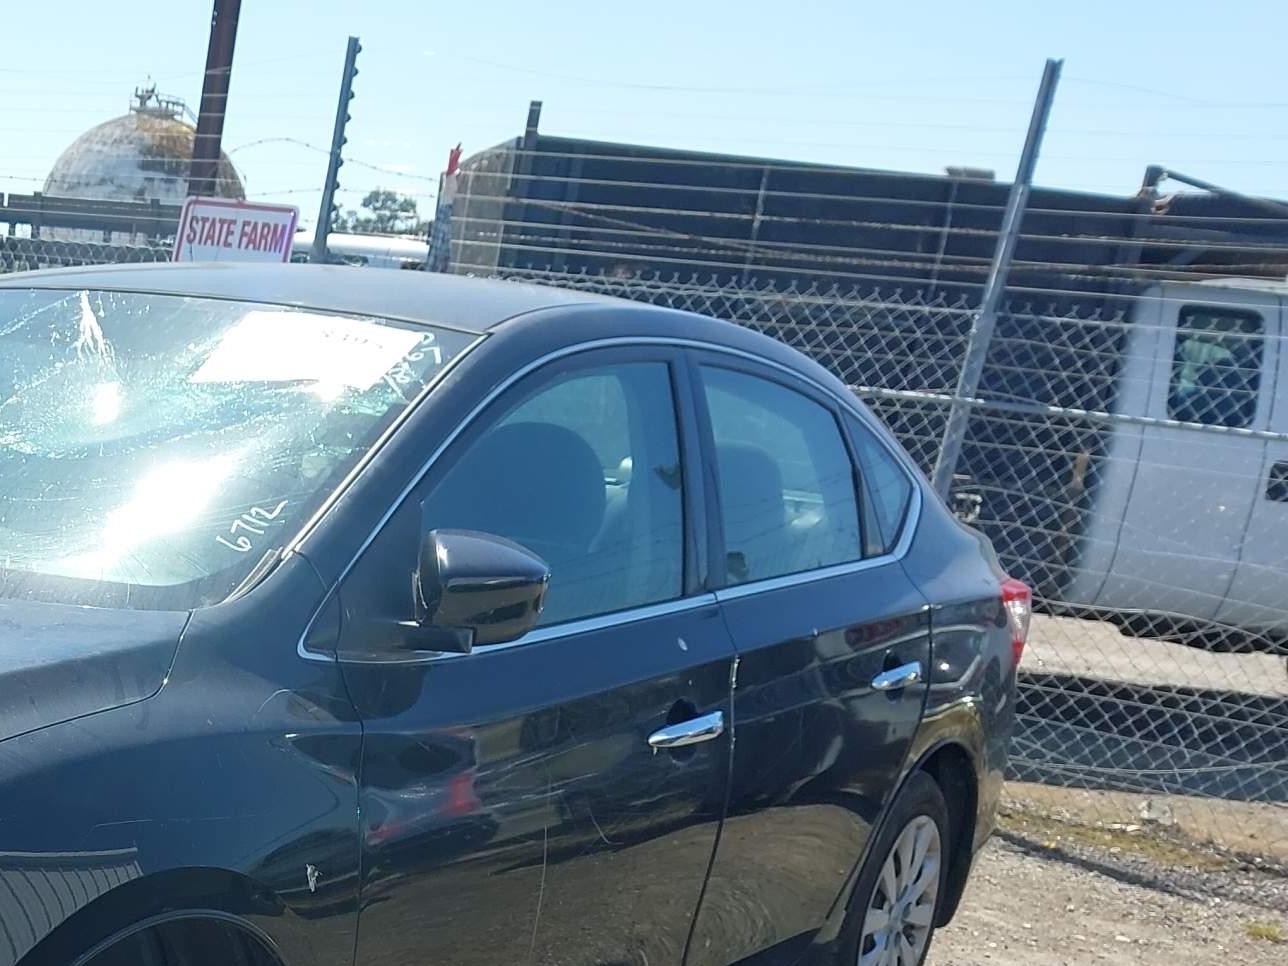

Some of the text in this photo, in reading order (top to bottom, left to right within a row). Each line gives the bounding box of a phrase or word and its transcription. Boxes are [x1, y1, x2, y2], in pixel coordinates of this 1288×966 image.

[186, 216, 288, 254] STATE FARM
[216, 500, 288, 552] 6712
